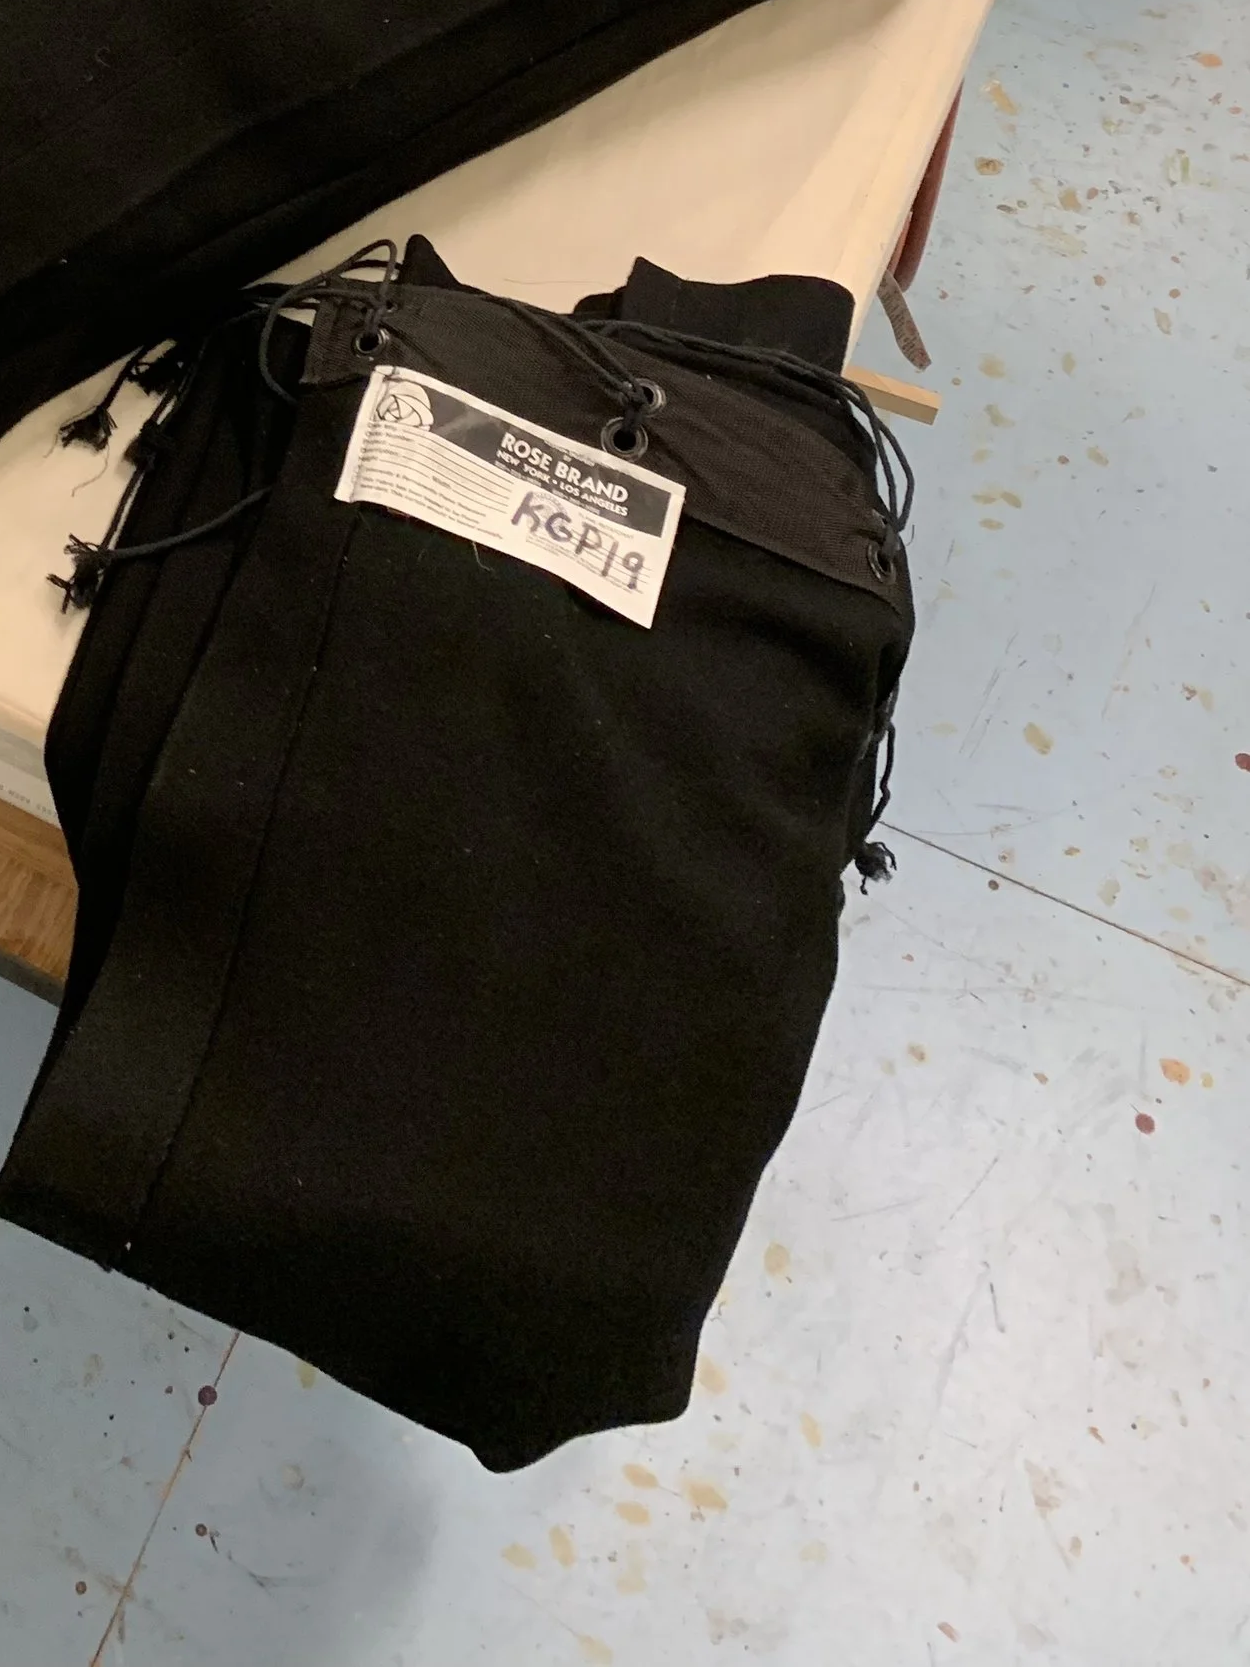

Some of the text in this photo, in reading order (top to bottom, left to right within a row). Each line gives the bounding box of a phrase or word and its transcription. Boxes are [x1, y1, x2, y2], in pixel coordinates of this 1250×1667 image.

[496, 449, 521, 467] NEW
[523, 463, 551, 484] YORK
[559, 481, 580, 497] LOS
[581, 493, 629, 517] ANGELES
[501, 432, 553, 472] ROSE
[554, 461, 629, 503] BRAND
